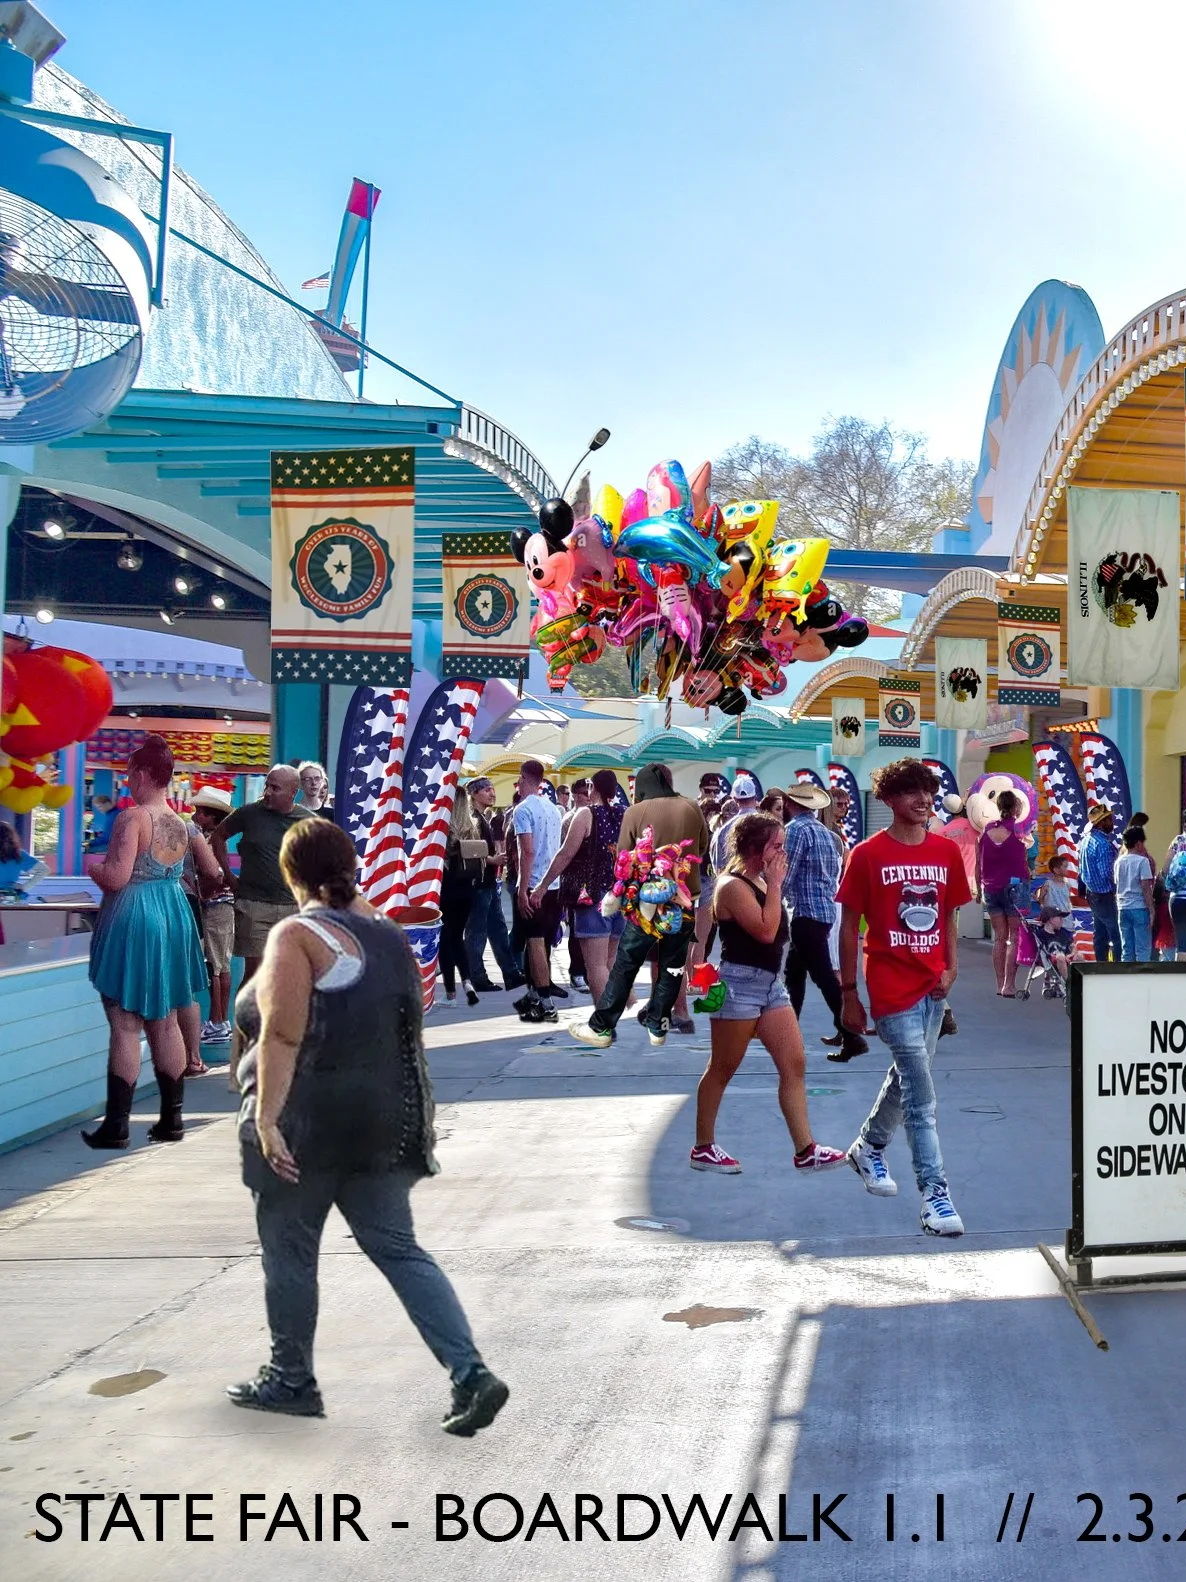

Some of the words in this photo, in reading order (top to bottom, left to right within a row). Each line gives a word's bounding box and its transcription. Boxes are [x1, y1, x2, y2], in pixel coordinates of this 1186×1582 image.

[305, 532, 323, 551] OVER
[340, 527, 368, 540] YEARS
[369, 540, 378, 550] OF
[300, 576, 340, 612] WHOLESOME
[344, 594, 372, 612] FAMILY
[372, 576, 382, 596] FUN
[1080, 562, 1089, 618] ILLINOIS
[882, 866, 948, 886] CENTENNIAL
[1148, 1102, 1186, 1136] ON
